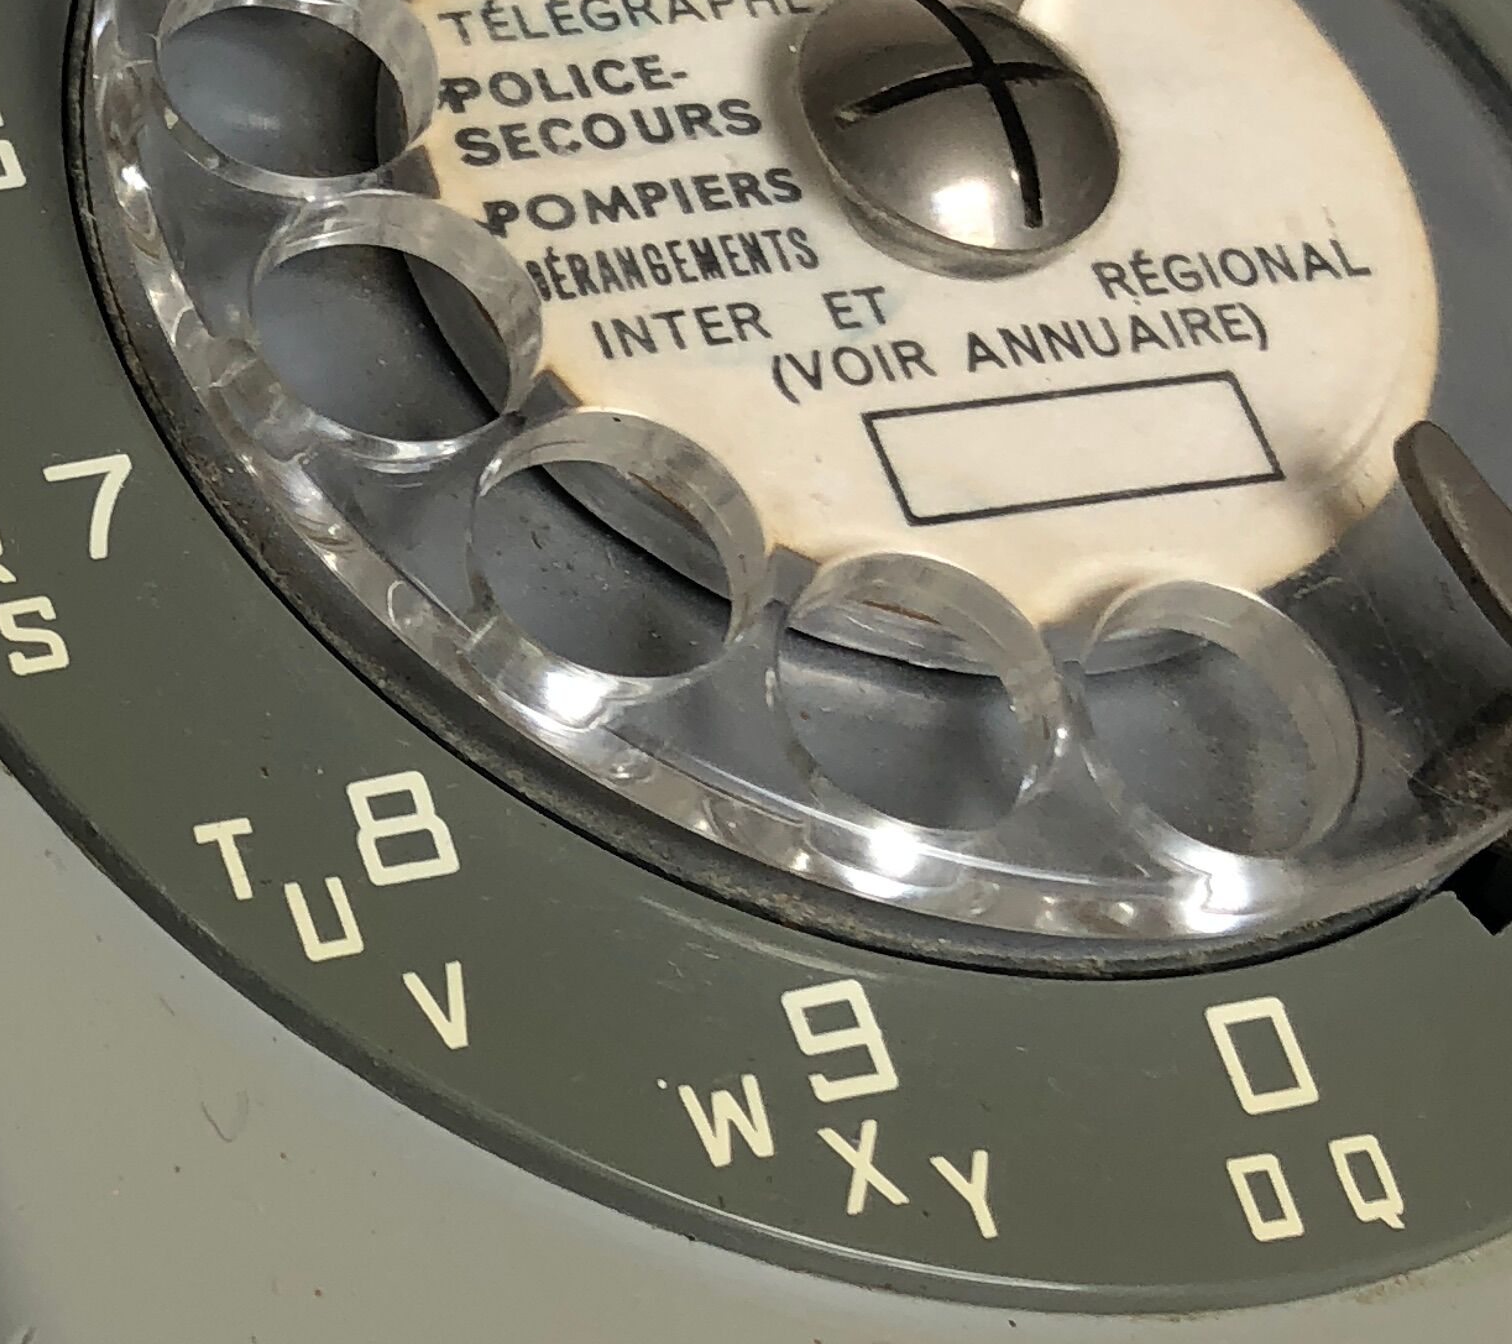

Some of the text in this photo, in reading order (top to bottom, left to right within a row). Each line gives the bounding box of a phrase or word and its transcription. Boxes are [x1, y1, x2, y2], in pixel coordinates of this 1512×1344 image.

[437, 54, 688, 114] POLICE-
[454, 98, 763, 168] SECOURS
[475, 166, 804, 237] POMPIERS
[525, 225, 820, 303] DÉRANGEMENTS
[591, 238, 1372, 360] INTER ET RÉGIONAL
[770, 301, 1269, 405] (VOIR ANNUAIRE)
[42, 453, 133, 560] 7
[345, 770, 461, 887] 8
[780, 978, 900, 1103] 9
[1203, 995, 1321, 1116] 0
